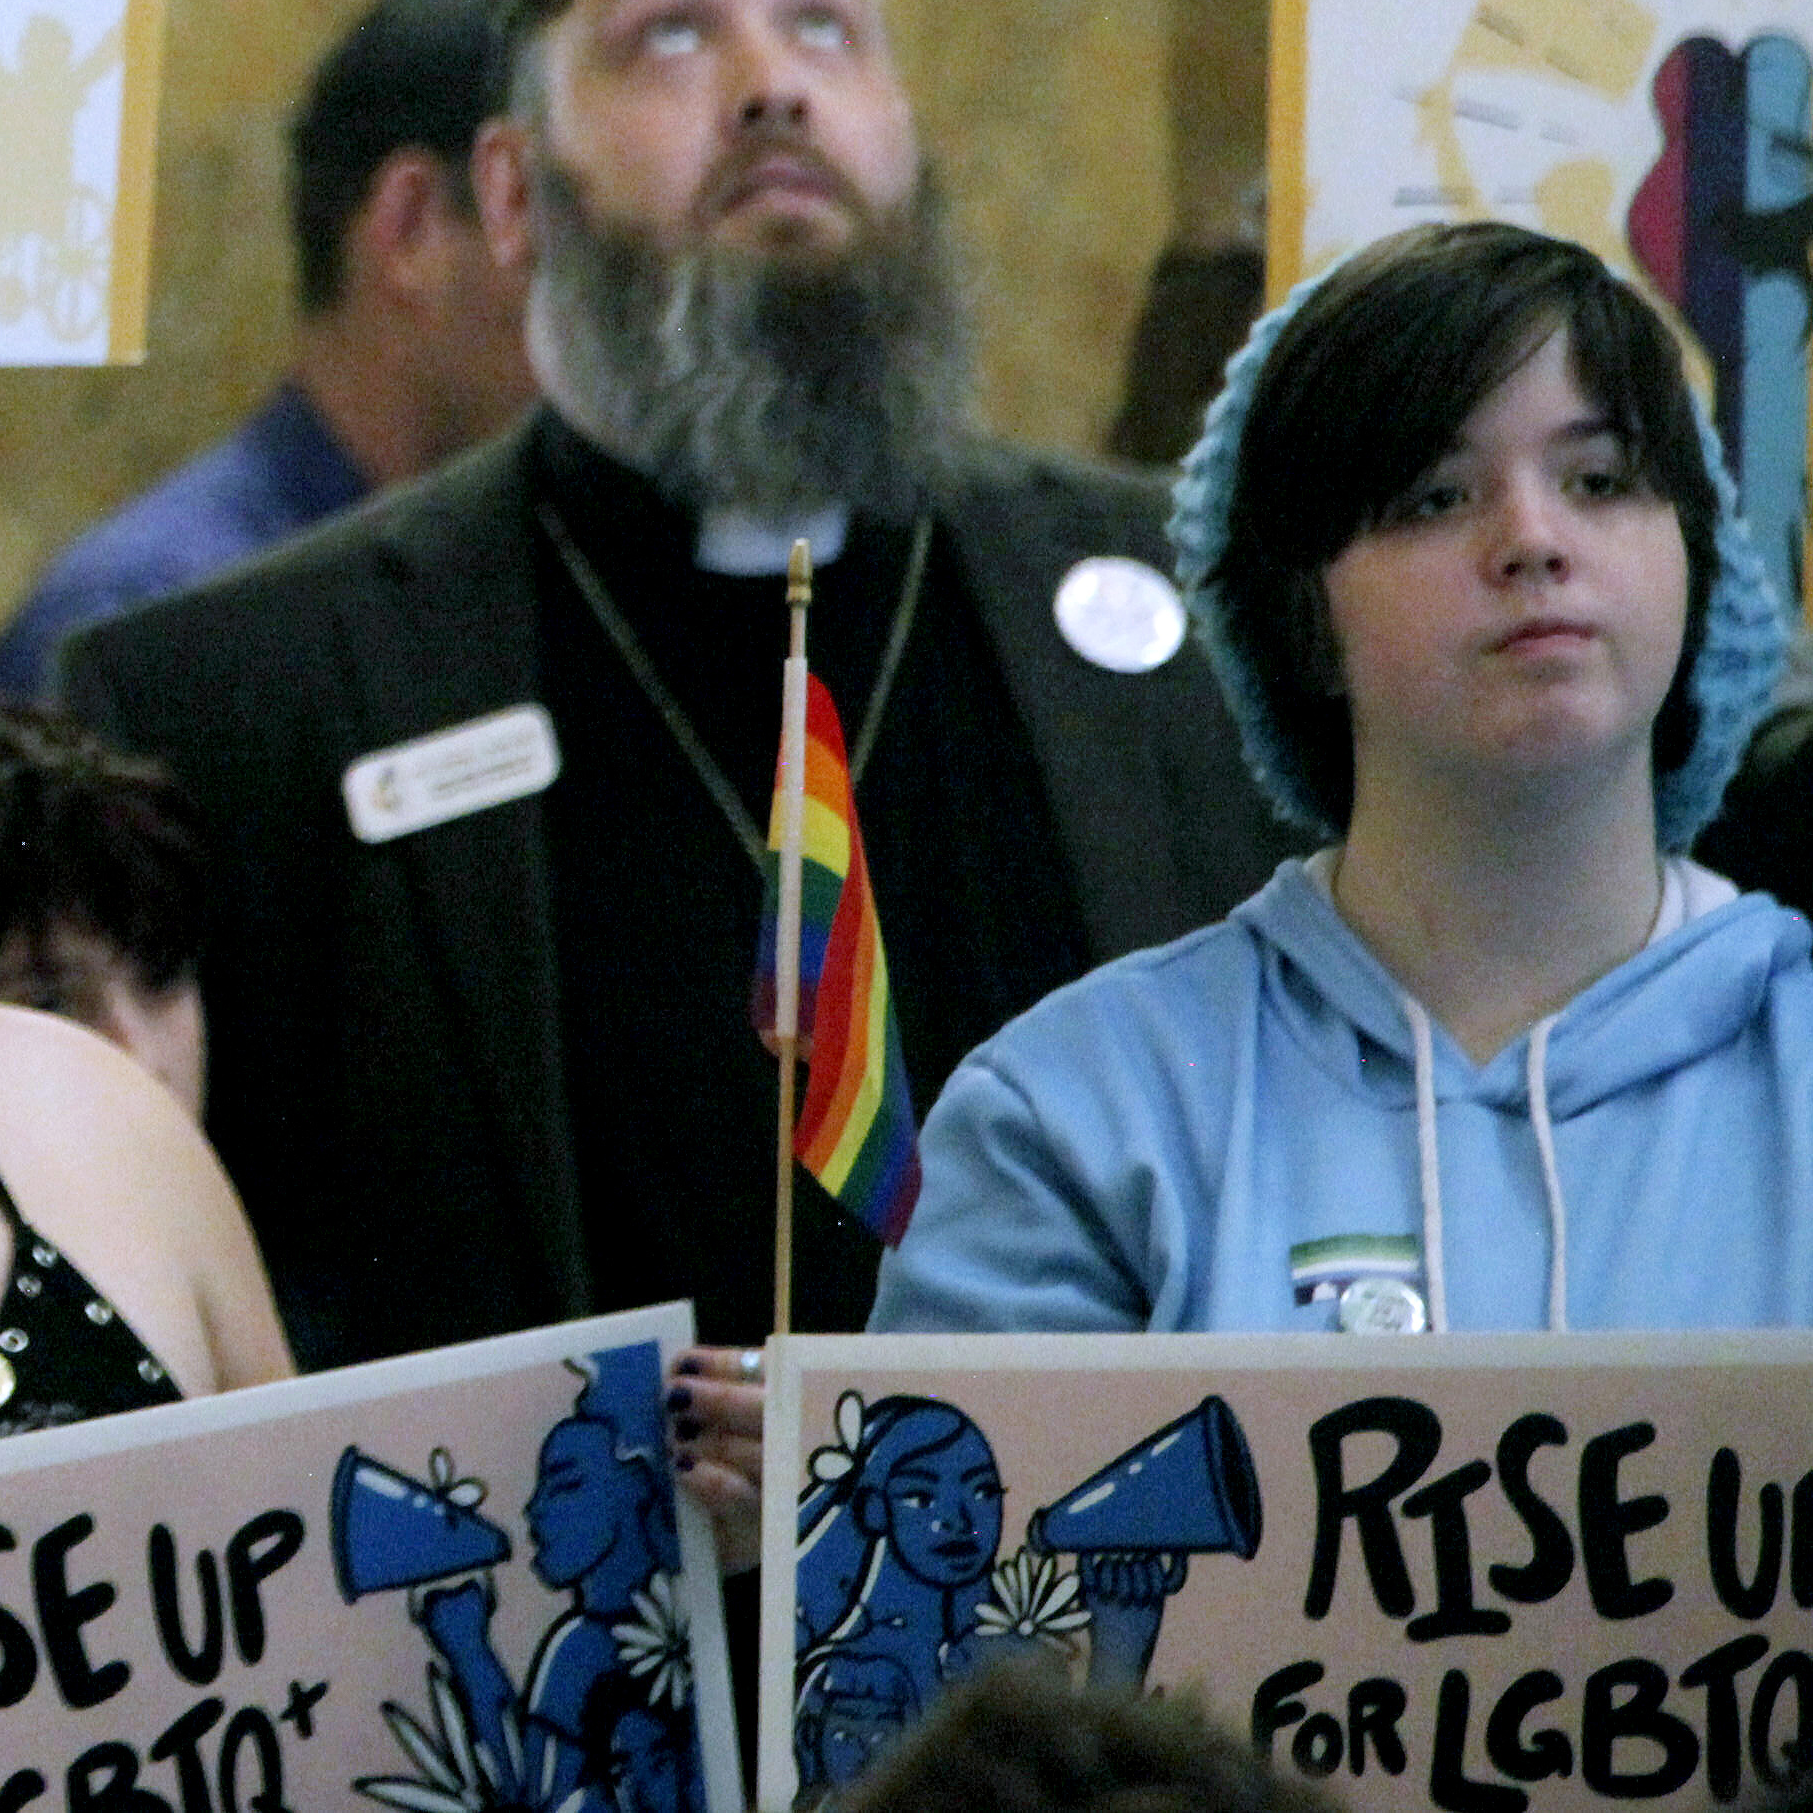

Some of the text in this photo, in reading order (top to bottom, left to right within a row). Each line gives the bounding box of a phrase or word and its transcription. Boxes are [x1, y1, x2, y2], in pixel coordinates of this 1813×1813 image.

[148, 1508, 306, 1686] UP
[1304, 1396, 1813, 1643] RISE U
[1251, 1660, 1408, 1778] FOR
